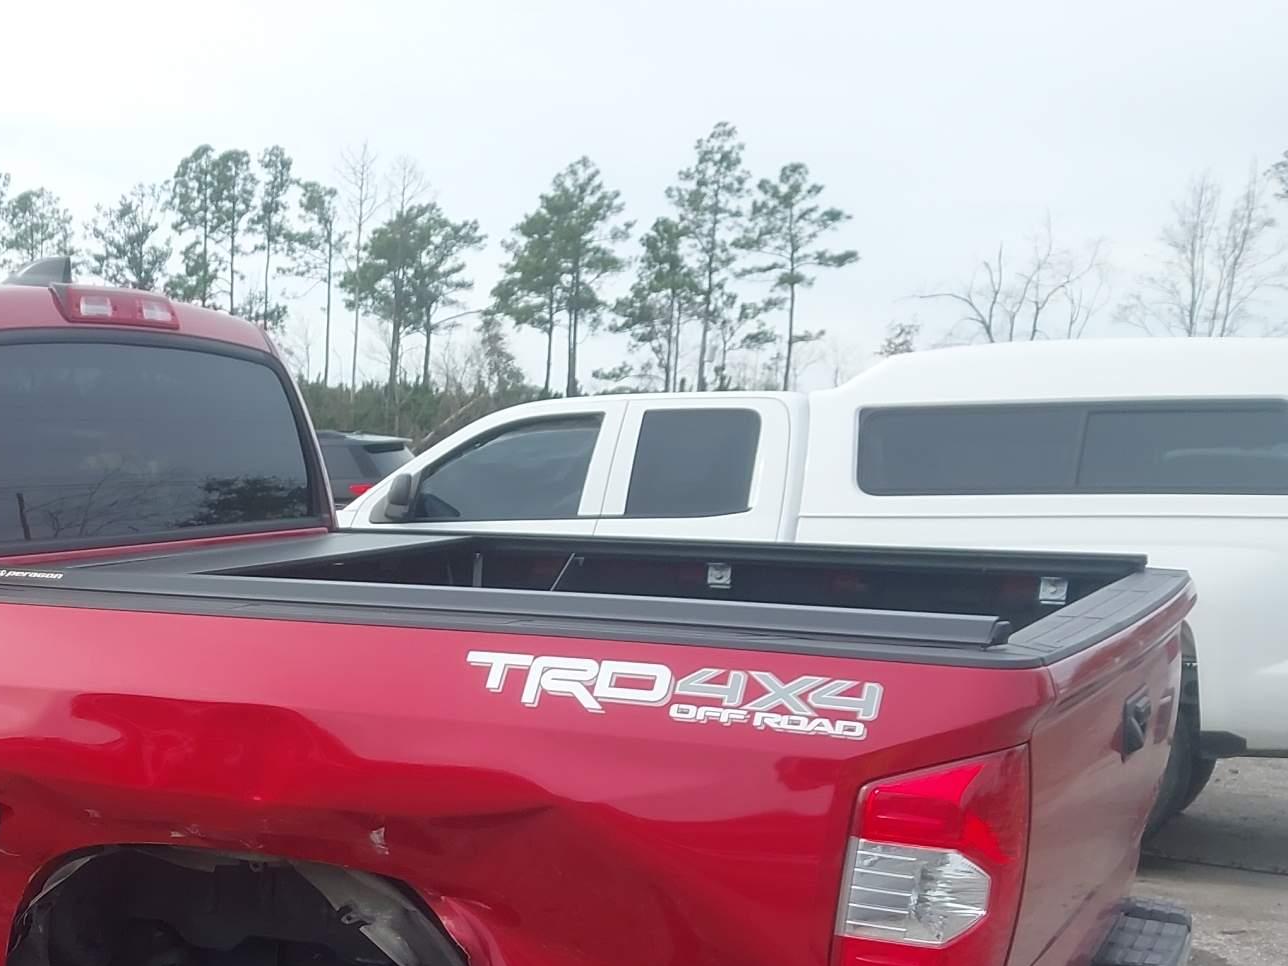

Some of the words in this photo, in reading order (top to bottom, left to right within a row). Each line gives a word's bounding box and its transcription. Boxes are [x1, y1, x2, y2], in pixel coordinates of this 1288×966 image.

[466, 651, 673, 713] TRD
[671, 703, 751, 726] OFF
[752, 711, 868, 741] ROAD
